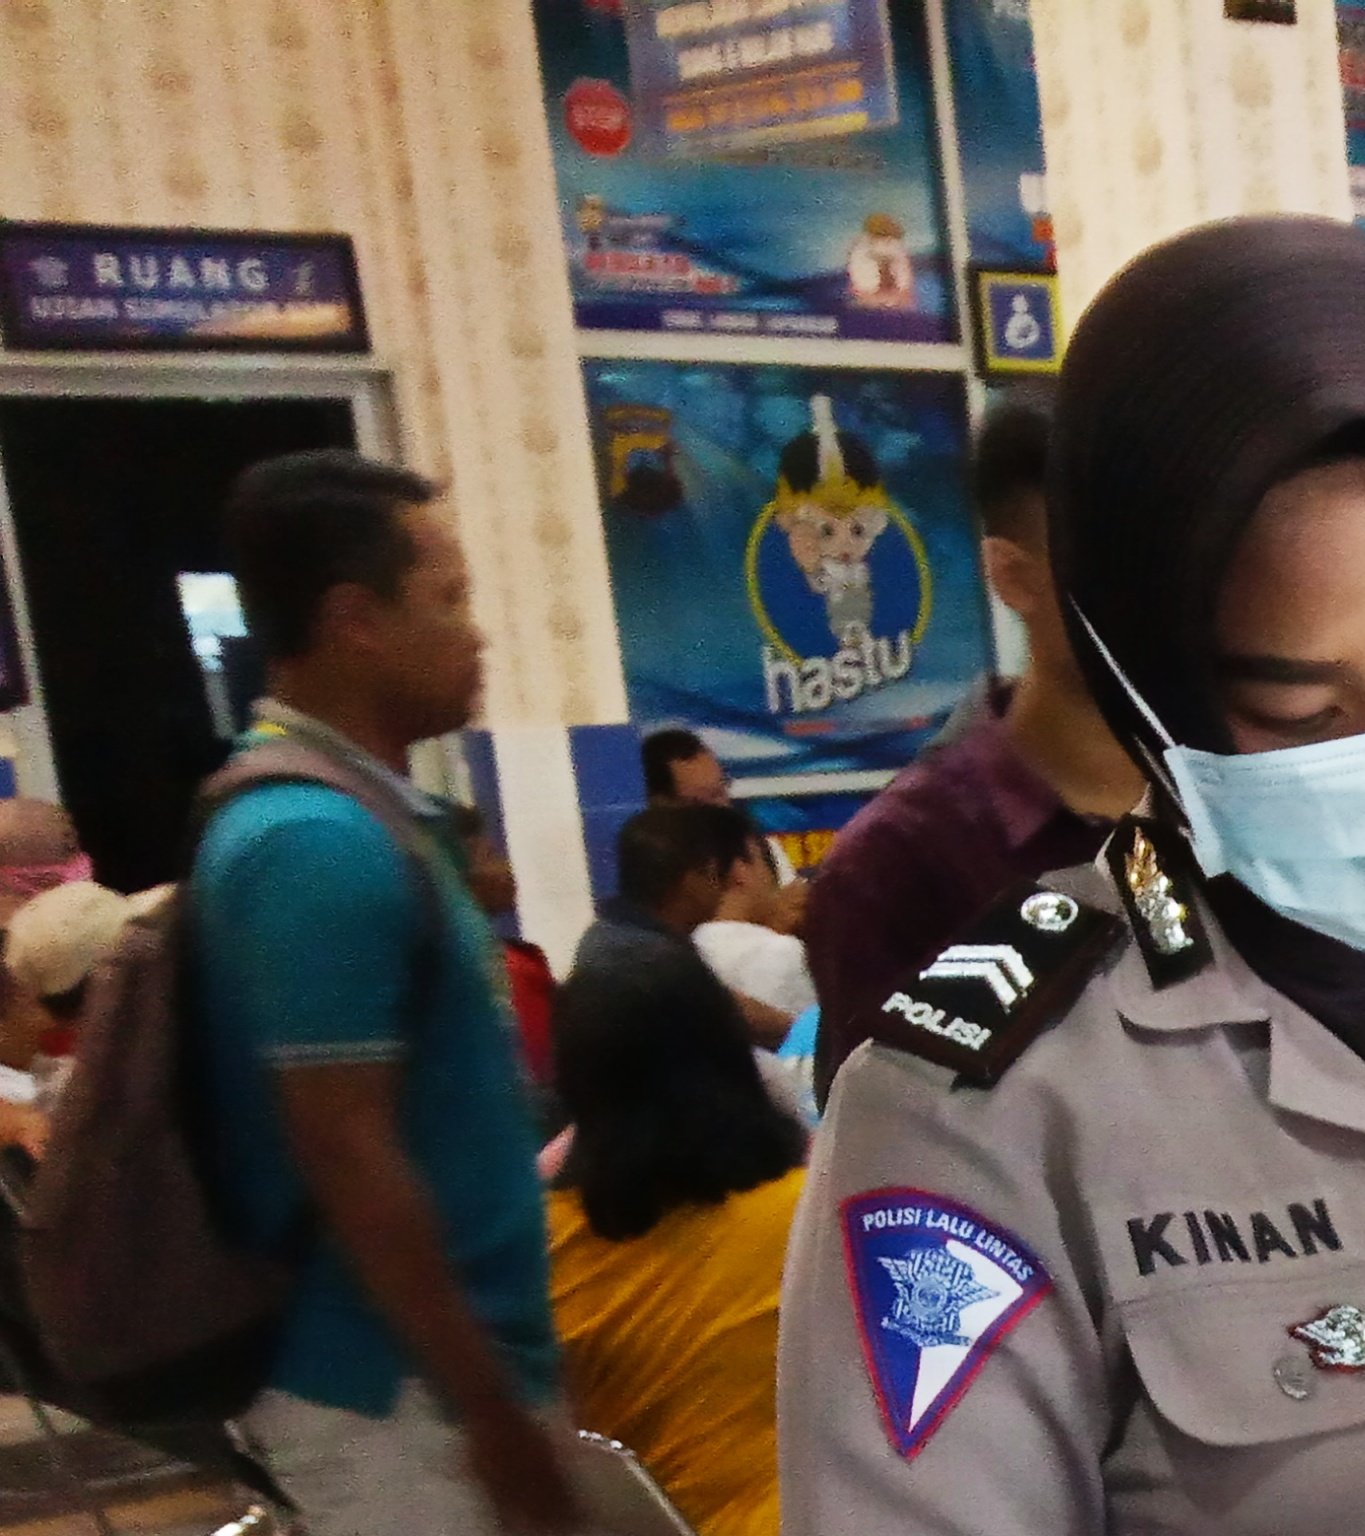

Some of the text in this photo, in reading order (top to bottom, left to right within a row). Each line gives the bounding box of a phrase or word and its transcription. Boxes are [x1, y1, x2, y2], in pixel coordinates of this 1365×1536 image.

[94, 252, 270, 292] RUANG
[881, 991, 993, 1051] POLISI
[862, 1207, 1035, 1282] POLISI LALU LINTAS
[1126, 1198, 1344, 1277] KINAN
